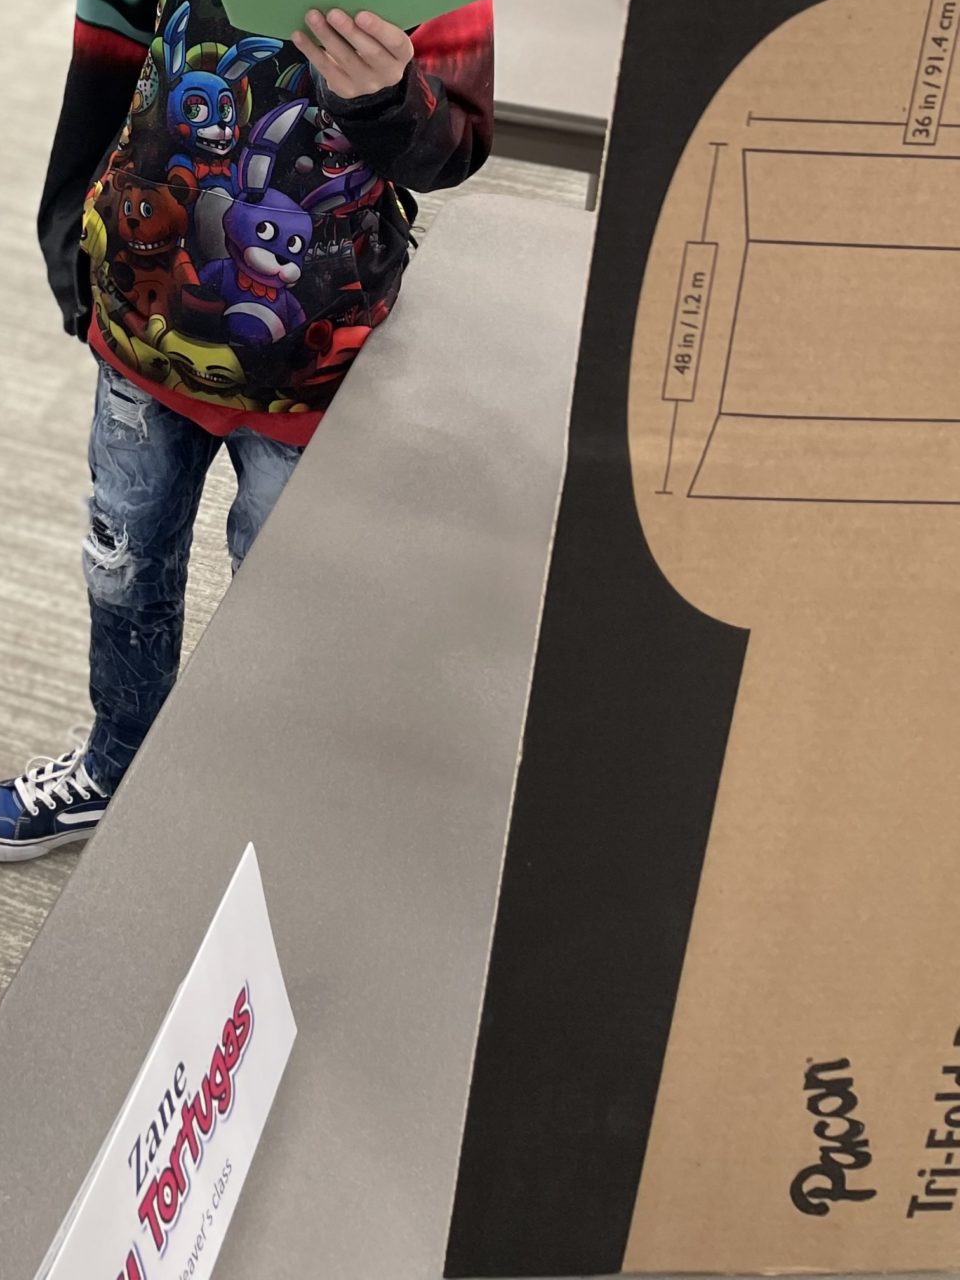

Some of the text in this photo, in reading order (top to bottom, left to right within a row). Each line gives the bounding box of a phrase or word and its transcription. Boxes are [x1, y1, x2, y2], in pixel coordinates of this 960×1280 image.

[912, 2, 956, 138] 36 in / 91.4 cm
[673, 272, 706, 375] 48 in / 1.2 m
[128, 1061, 187, 1196] Zane
[138, 983, 253, 1254] Tortugas
[790, 1057, 877, 1216] Pacon
[178, 1158, 233, 1280] eaver's class
